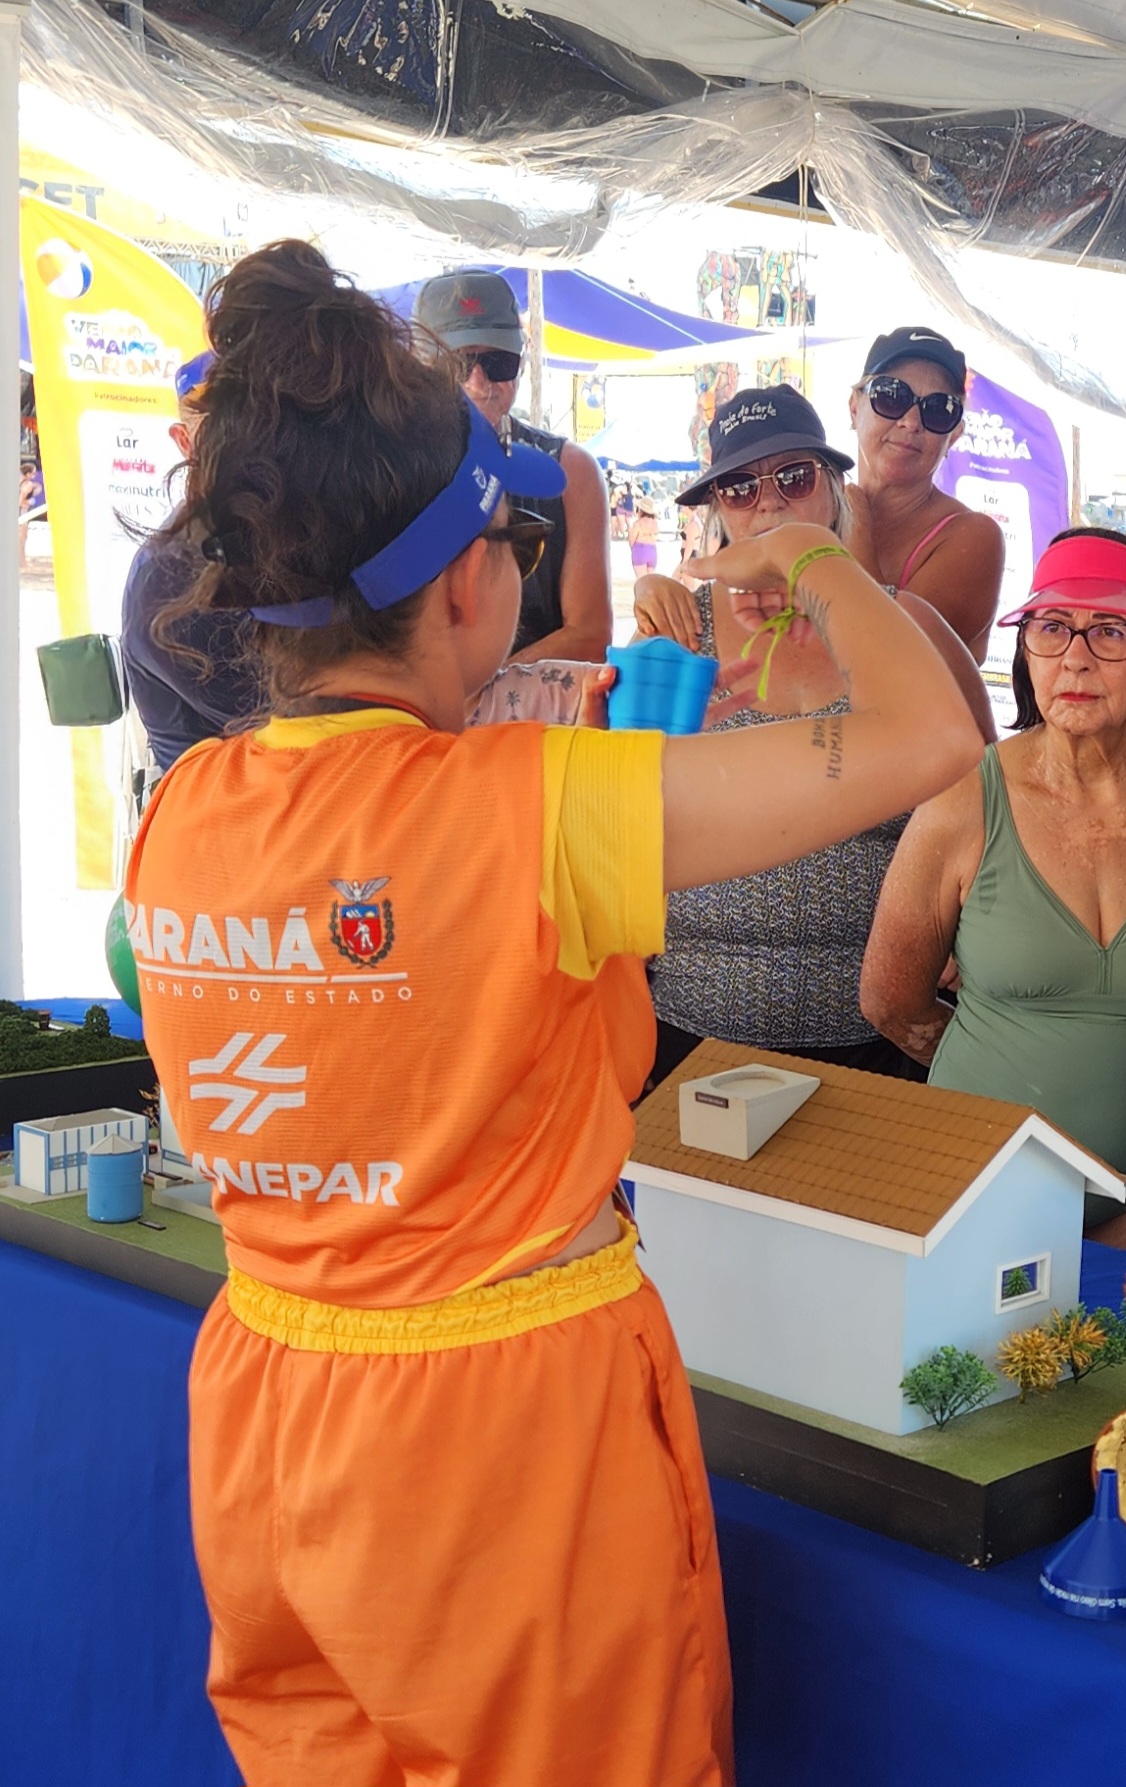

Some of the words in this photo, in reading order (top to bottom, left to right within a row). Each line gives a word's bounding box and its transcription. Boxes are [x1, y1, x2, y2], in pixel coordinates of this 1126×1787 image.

[70, 319, 142, 337] VEO
[146, 979, 204, 1000] ERNO
[228, 987, 261, 1003] DO
[286, 986, 413, 1005] ESTADO
[191, 1151, 404, 1208] ANEPAR
